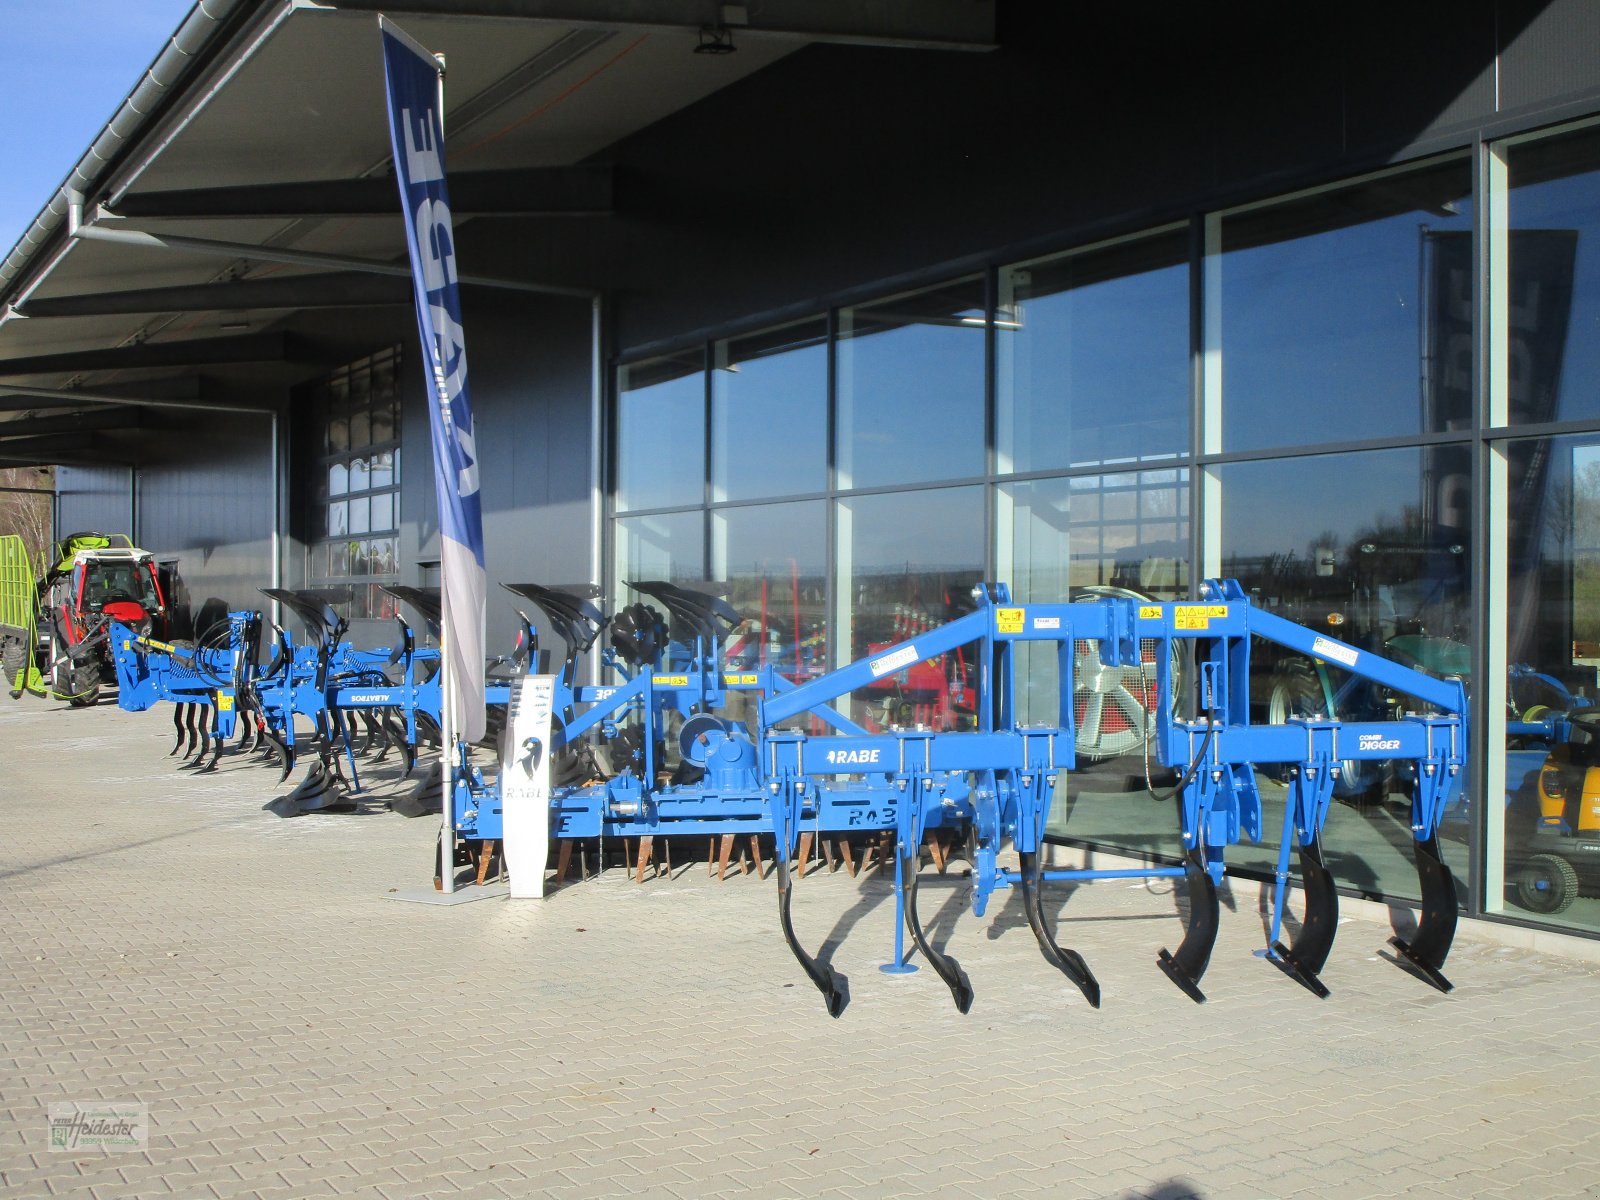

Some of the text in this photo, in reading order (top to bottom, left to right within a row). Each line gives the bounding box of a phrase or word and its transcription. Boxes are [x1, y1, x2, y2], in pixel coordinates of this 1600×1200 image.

[351, 694, 389, 702] ALBATROS
[1359, 740, 1400, 750] DIGGER
[836, 749, 880, 764] RABE
[506, 787, 543, 798] RABE
